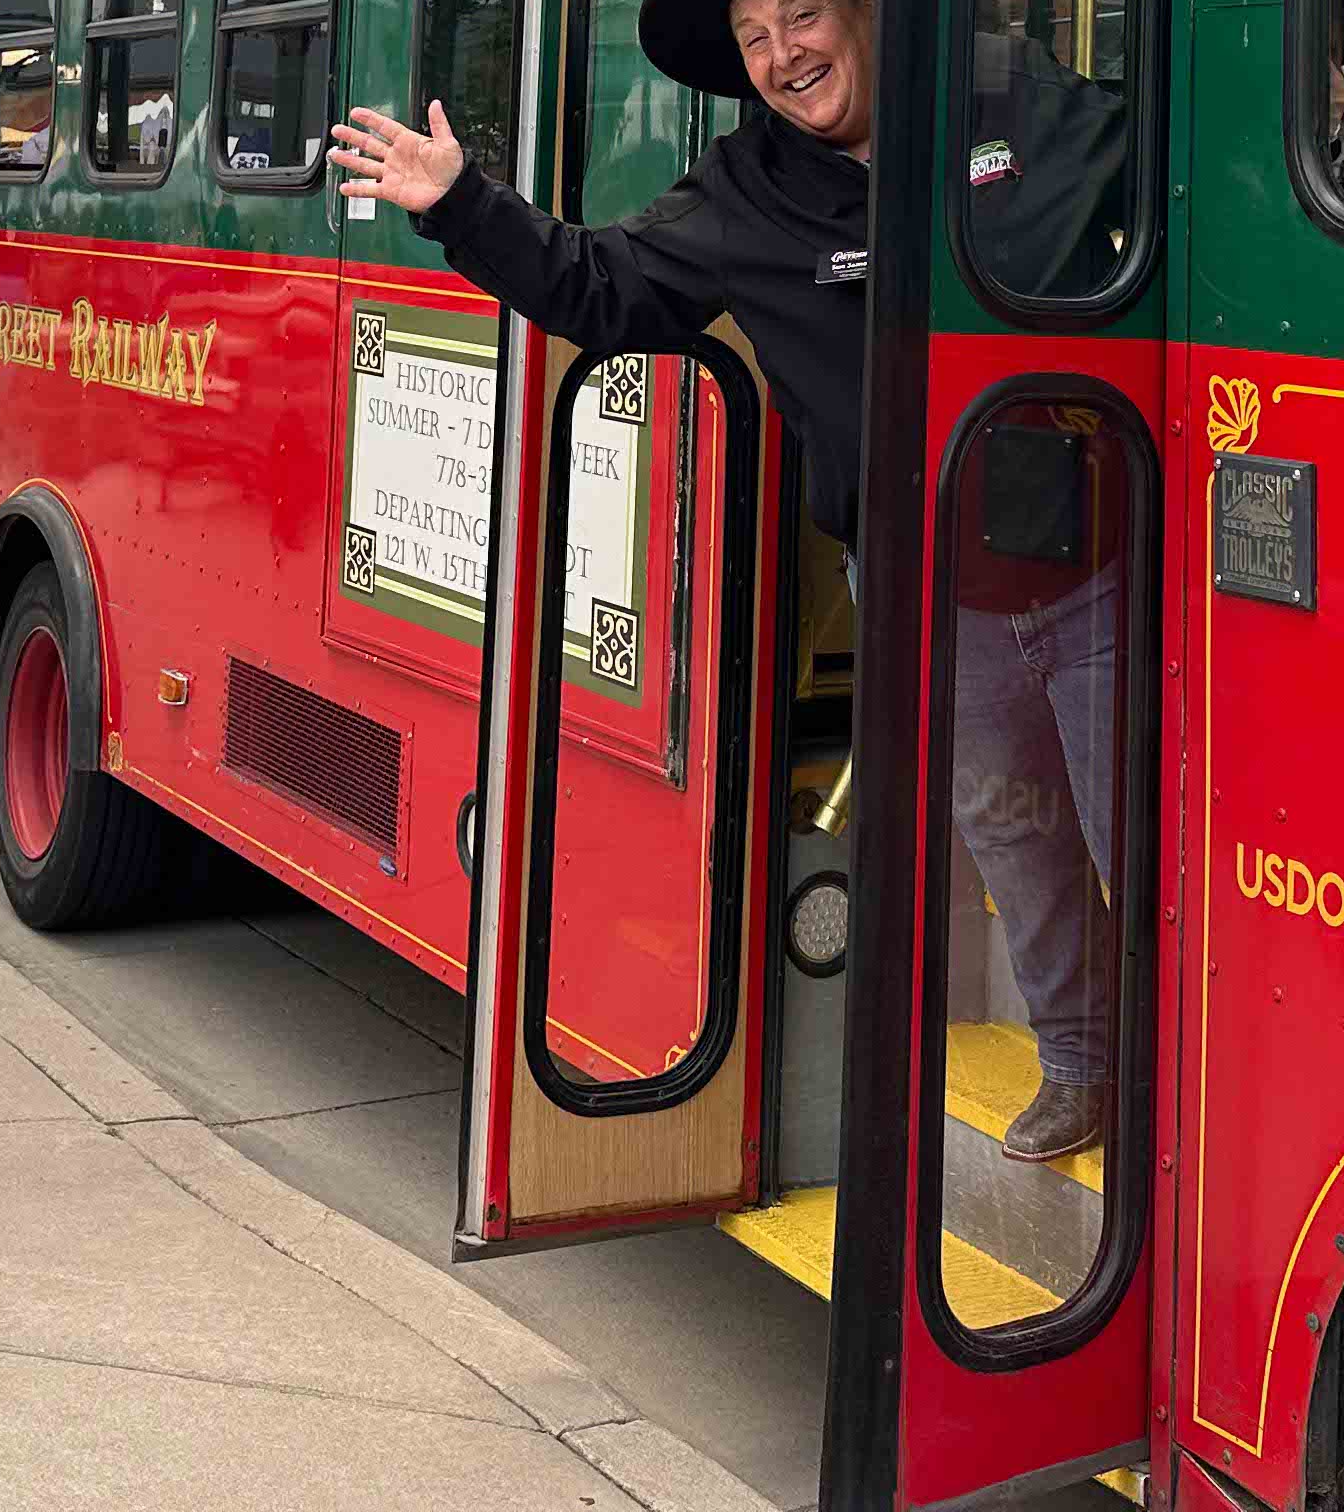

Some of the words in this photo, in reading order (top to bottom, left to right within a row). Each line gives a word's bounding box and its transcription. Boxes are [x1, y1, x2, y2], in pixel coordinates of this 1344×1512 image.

[969, 151, 1013, 182] ROLLEY
[69, 295, 218, 406] RAILWAY
[395, 361, 492, 406] HISTORIC
[367, 396, 441, 440] SUMMER
[374, 488, 488, 548] DEPARTING
[1221, 468, 1294, 523] CLASSIC
[384, 533, 406, 566] 121
[442, 552, 487, 593] 15TH
[1221, 534, 1294, 582] TROLLEYS
